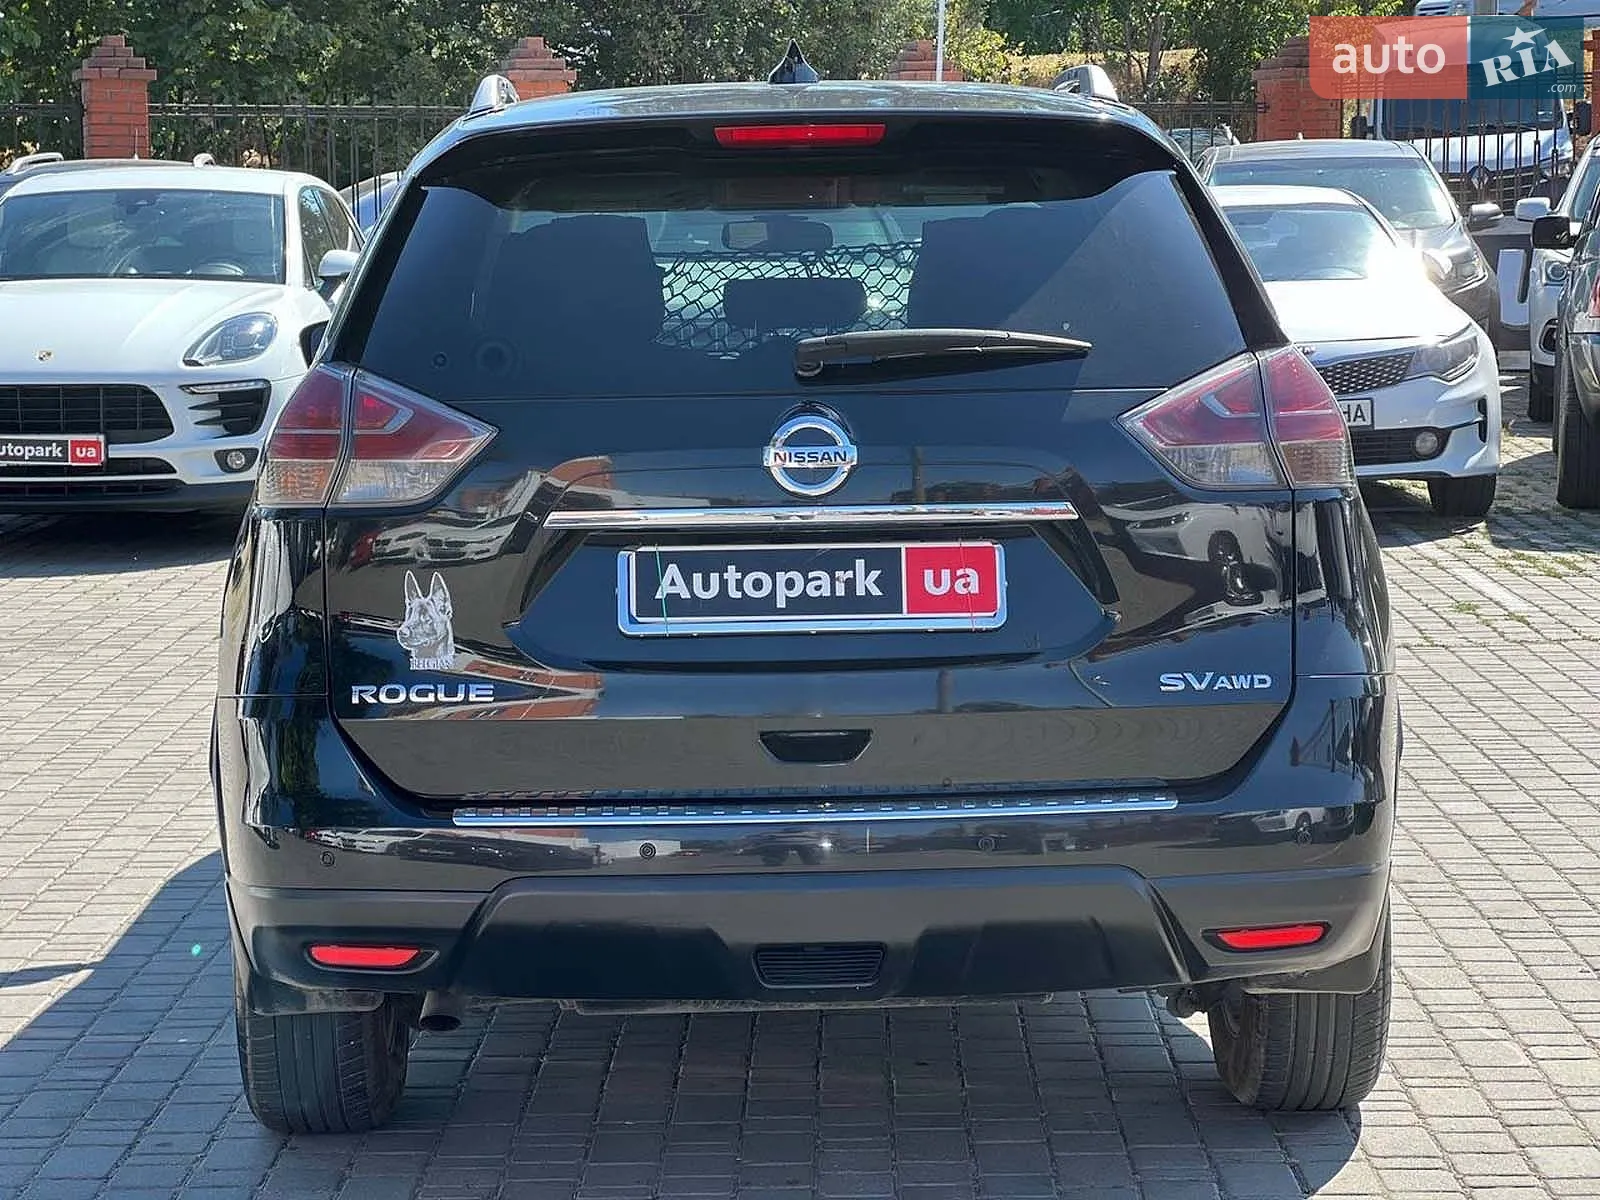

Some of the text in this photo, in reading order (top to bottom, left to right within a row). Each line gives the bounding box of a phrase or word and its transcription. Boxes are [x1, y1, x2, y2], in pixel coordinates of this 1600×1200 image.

[76, 447, 97, 457] ua
[774, 451, 847, 463] NISSAN
[655, 559, 980, 608] Autopark ua
[1160, 672, 1272, 691] SV AWD
[351, 683, 495, 704] ROGUE
